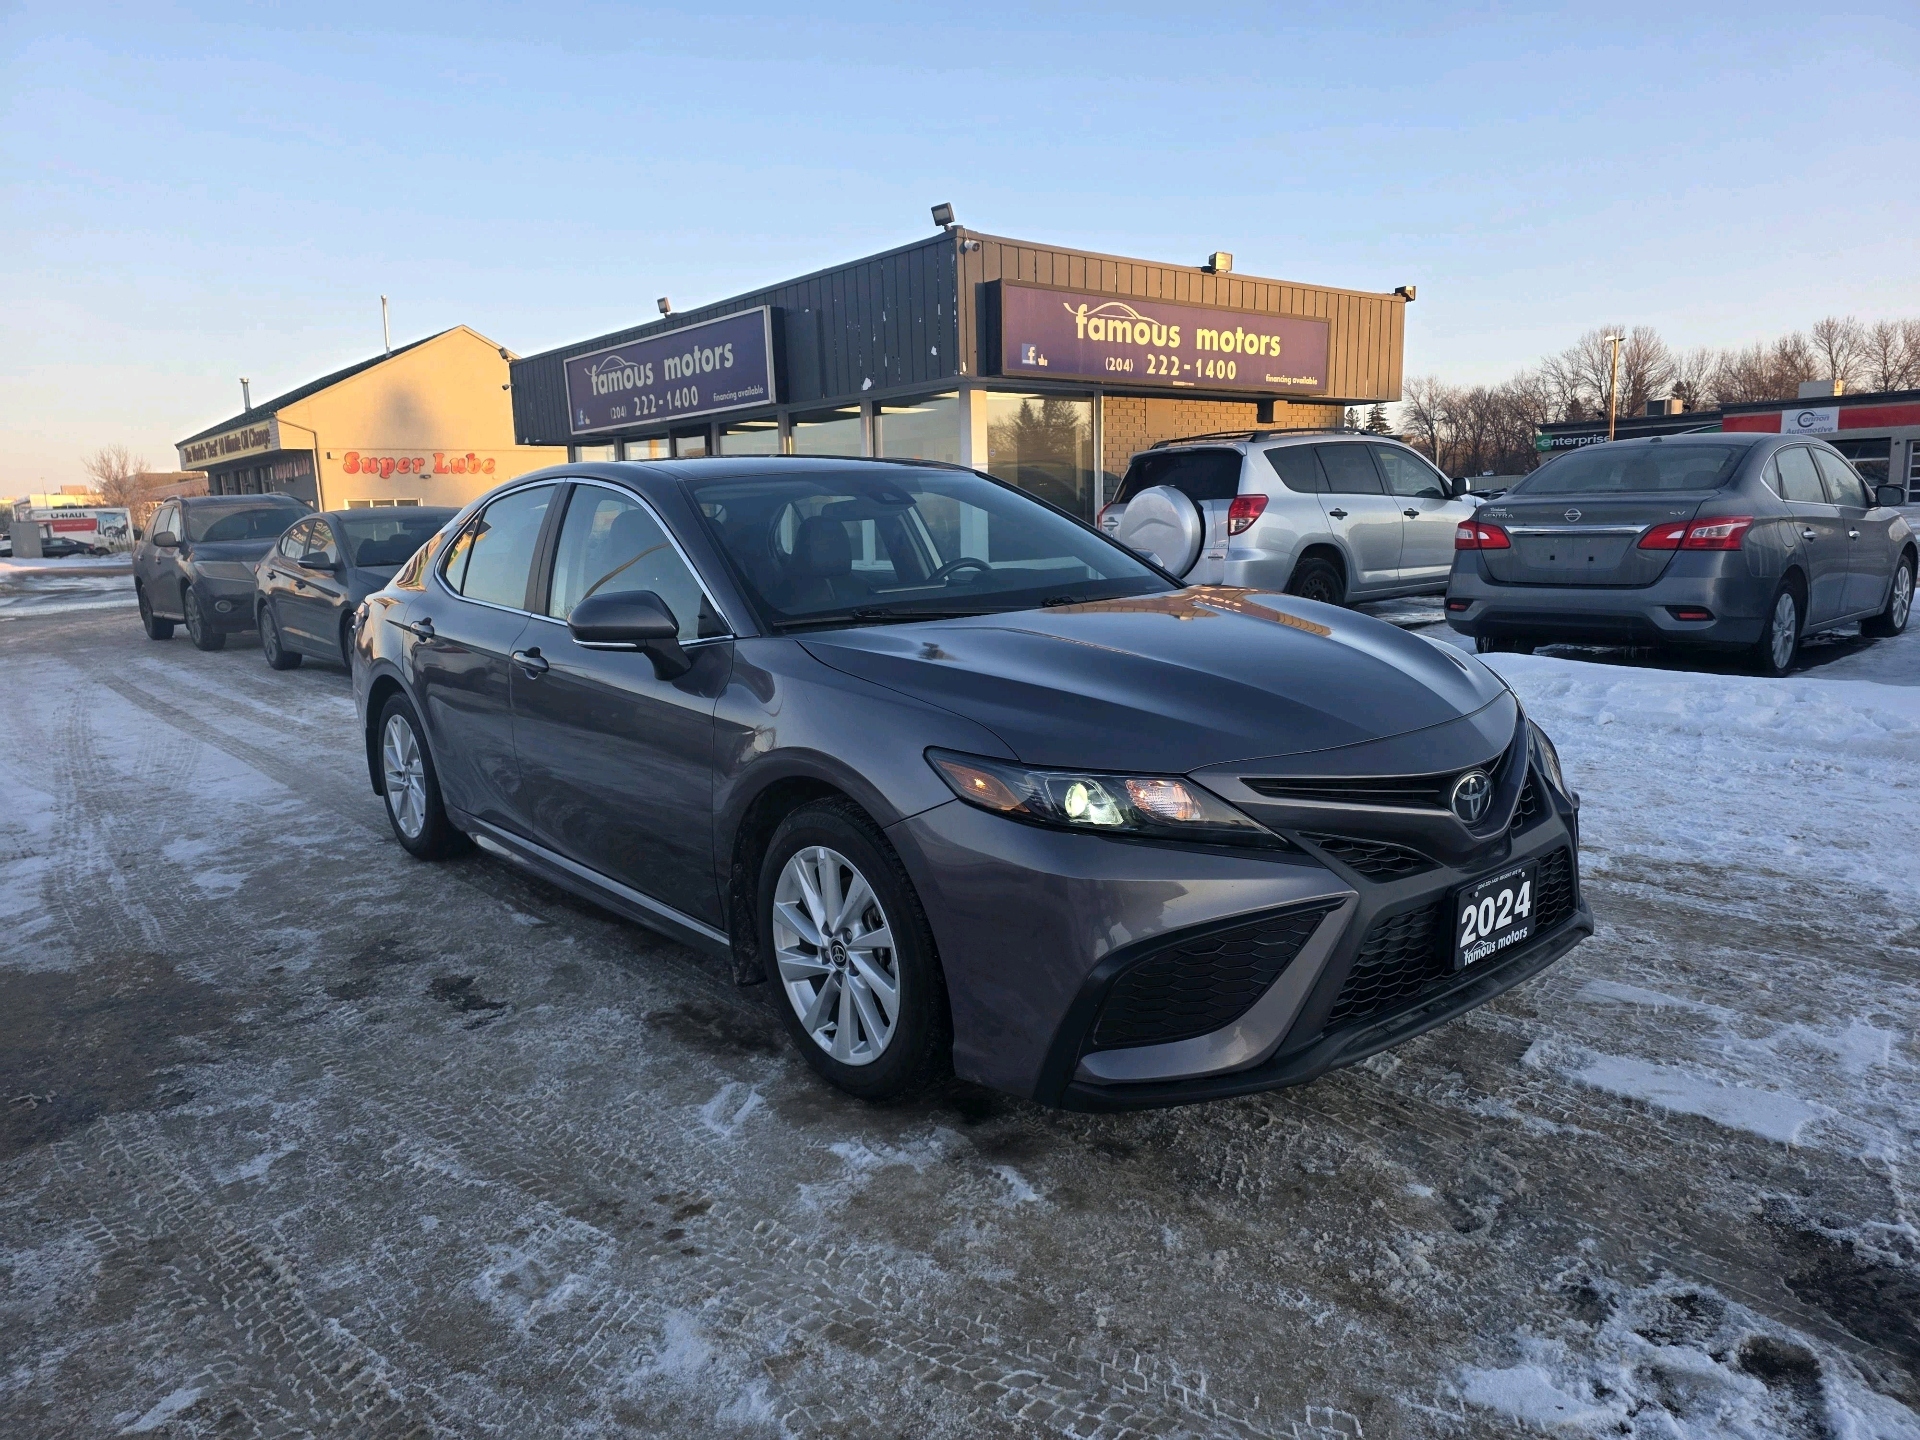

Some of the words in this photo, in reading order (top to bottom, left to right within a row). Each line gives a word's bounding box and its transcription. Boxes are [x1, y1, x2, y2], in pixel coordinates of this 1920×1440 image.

[1075, 304, 1181, 348] famous
[1196, 326, 1281, 357] motors
[591, 362, 654, 396] famous
[664, 343, 734, 381] motors
[1105, 356, 1134, 372] (204)
[1147, 354, 1237, 380] 222-1400
[1265, 373, 1292, 386] financing
[1292, 376, 1318, 386] available
[610, 405, 627, 419] (204)
[634, 385, 699, 416] 222-1400
[713, 390, 737, 402] financing
[737, 384, 764, 398] available
[224, 433, 241, 454] Minute
[240, 429, 250, 451] Oil
[249, 427, 271, 450] Change
[1785, 426, 1833, 435] Automotive
[343, 451, 425, 479] Super
[433, 452, 496, 474] Lube
[50, 511, 88, 519] U-HAUL
[1460, 881, 1531, 948] 2024
[1464, 941, 1496, 966] famous
[1497, 927, 1528, 949] motors
